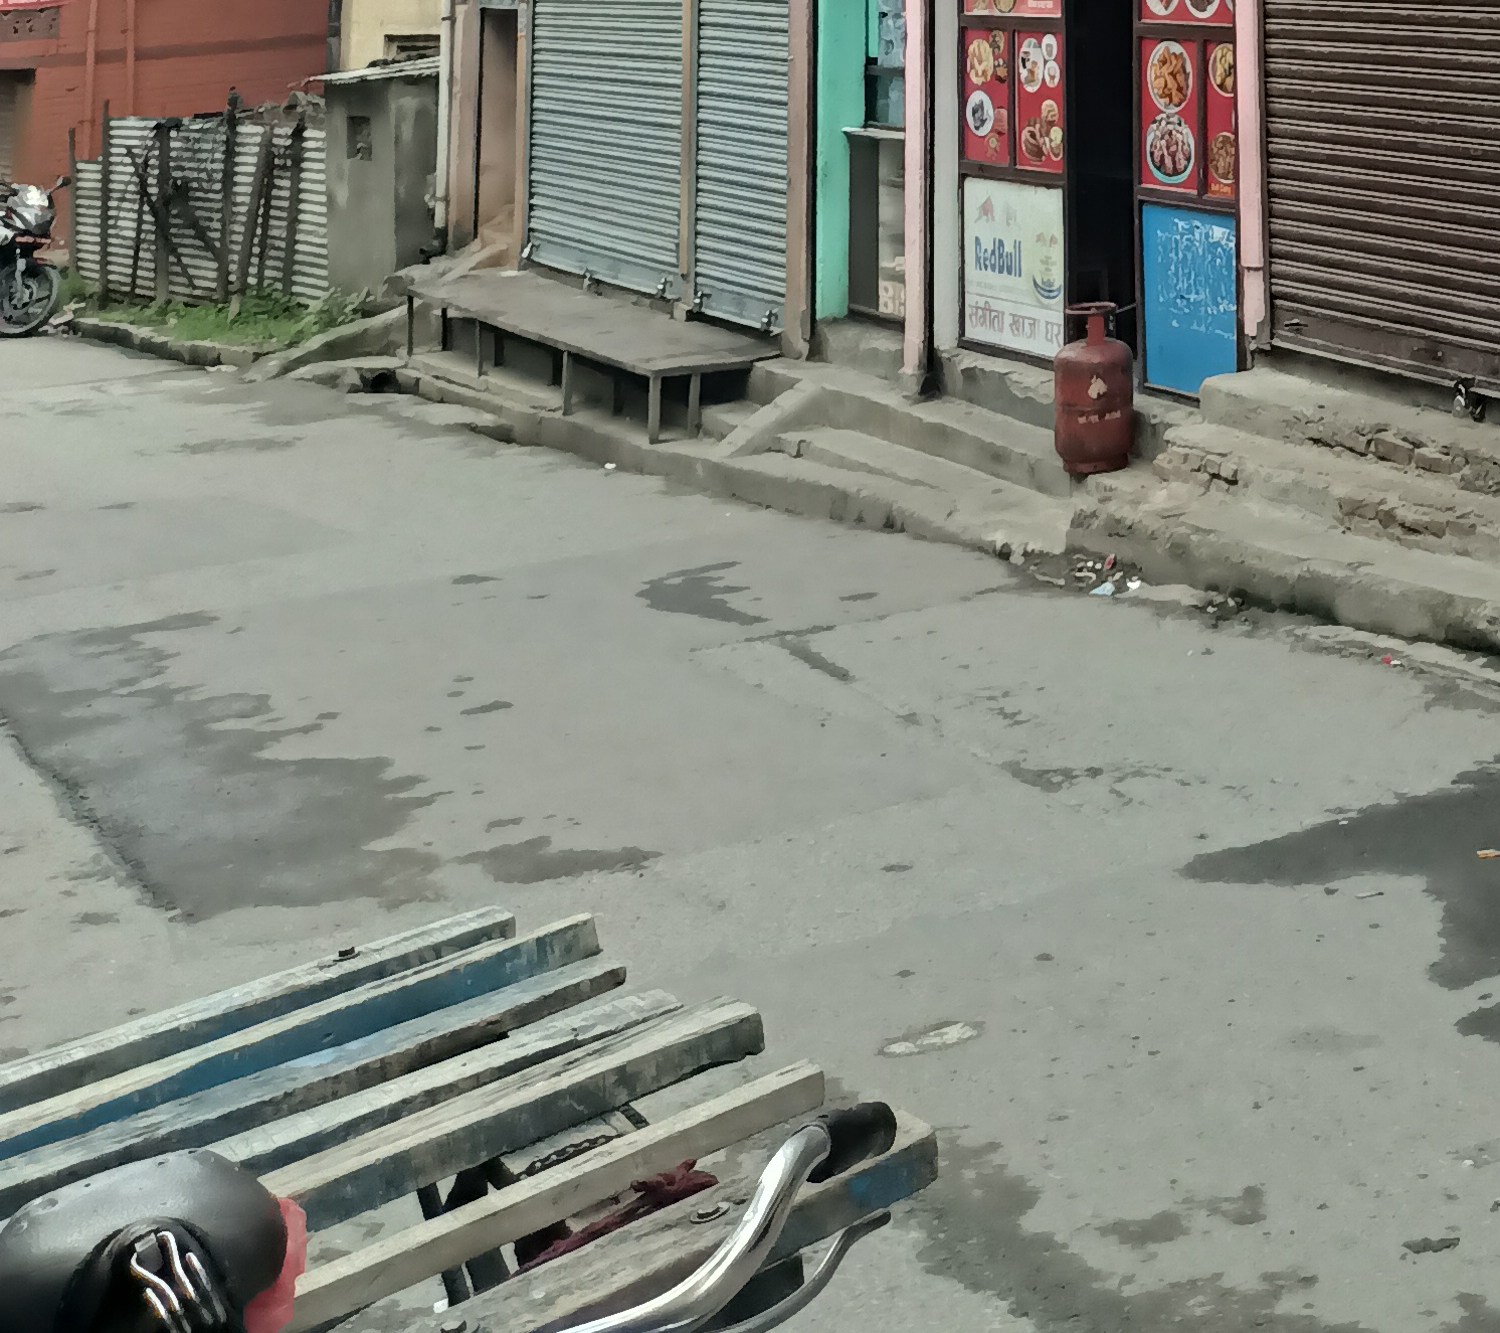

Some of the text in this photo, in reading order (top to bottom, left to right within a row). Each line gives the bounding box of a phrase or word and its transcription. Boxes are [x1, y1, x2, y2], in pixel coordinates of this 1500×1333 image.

[968, 300, 1063, 349] संगीता खाजा घर
